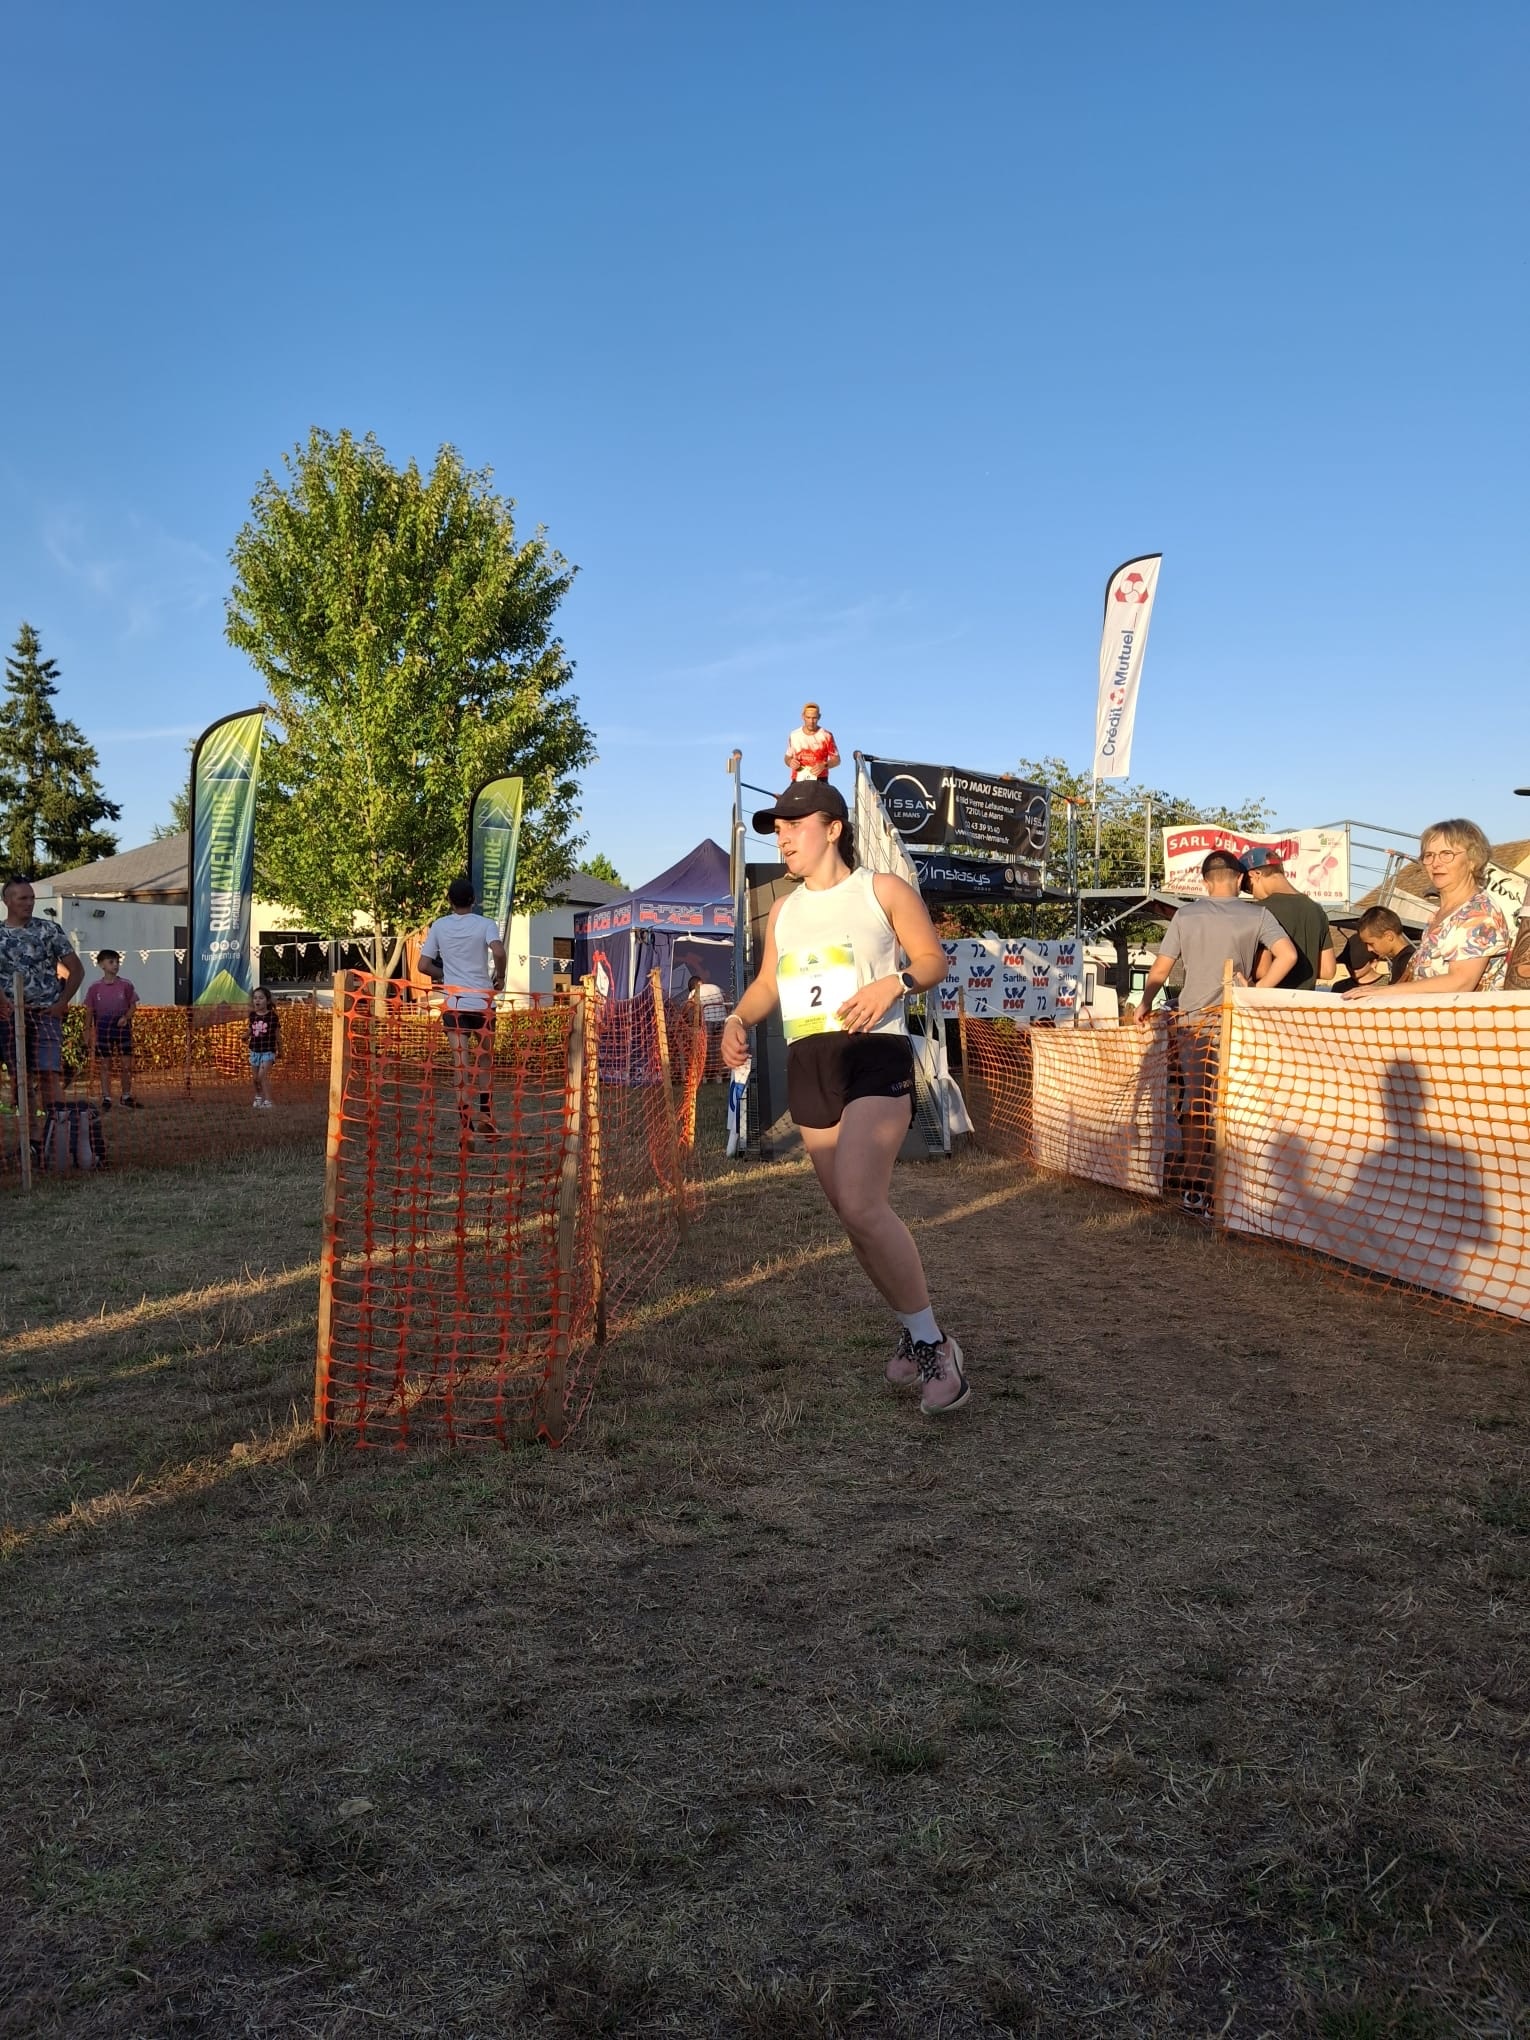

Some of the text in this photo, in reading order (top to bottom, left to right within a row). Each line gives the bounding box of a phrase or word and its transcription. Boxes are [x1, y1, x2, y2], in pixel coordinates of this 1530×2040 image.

[1102, 629, 1134, 756] Crédit Mutuel
[941, 776, 1023, 802] AUTO MAXI SERVICE
[902, 811, 921, 819] MANS
[971, 822, 978, 830] 43
[978, 823, 987, 831] 39
[1169, 835, 1210, 850] SARL
[930, 866, 991, 886] Instasys
[971, 943, 987, 958] 72
[1037, 942, 1049, 957] 72
[1003, 955, 1025, 966] FSGT
[945, 973, 960, 983] the
[967, 977, 994, 988] FSGT
[1002, 973, 1027, 983] Sarthe
[810, 985, 822, 1008] 2
[1037, 996, 1047, 1010] 72
[974, 997, 988, 1013] 72
[1003, 999, 1025, 1009] FSGT
